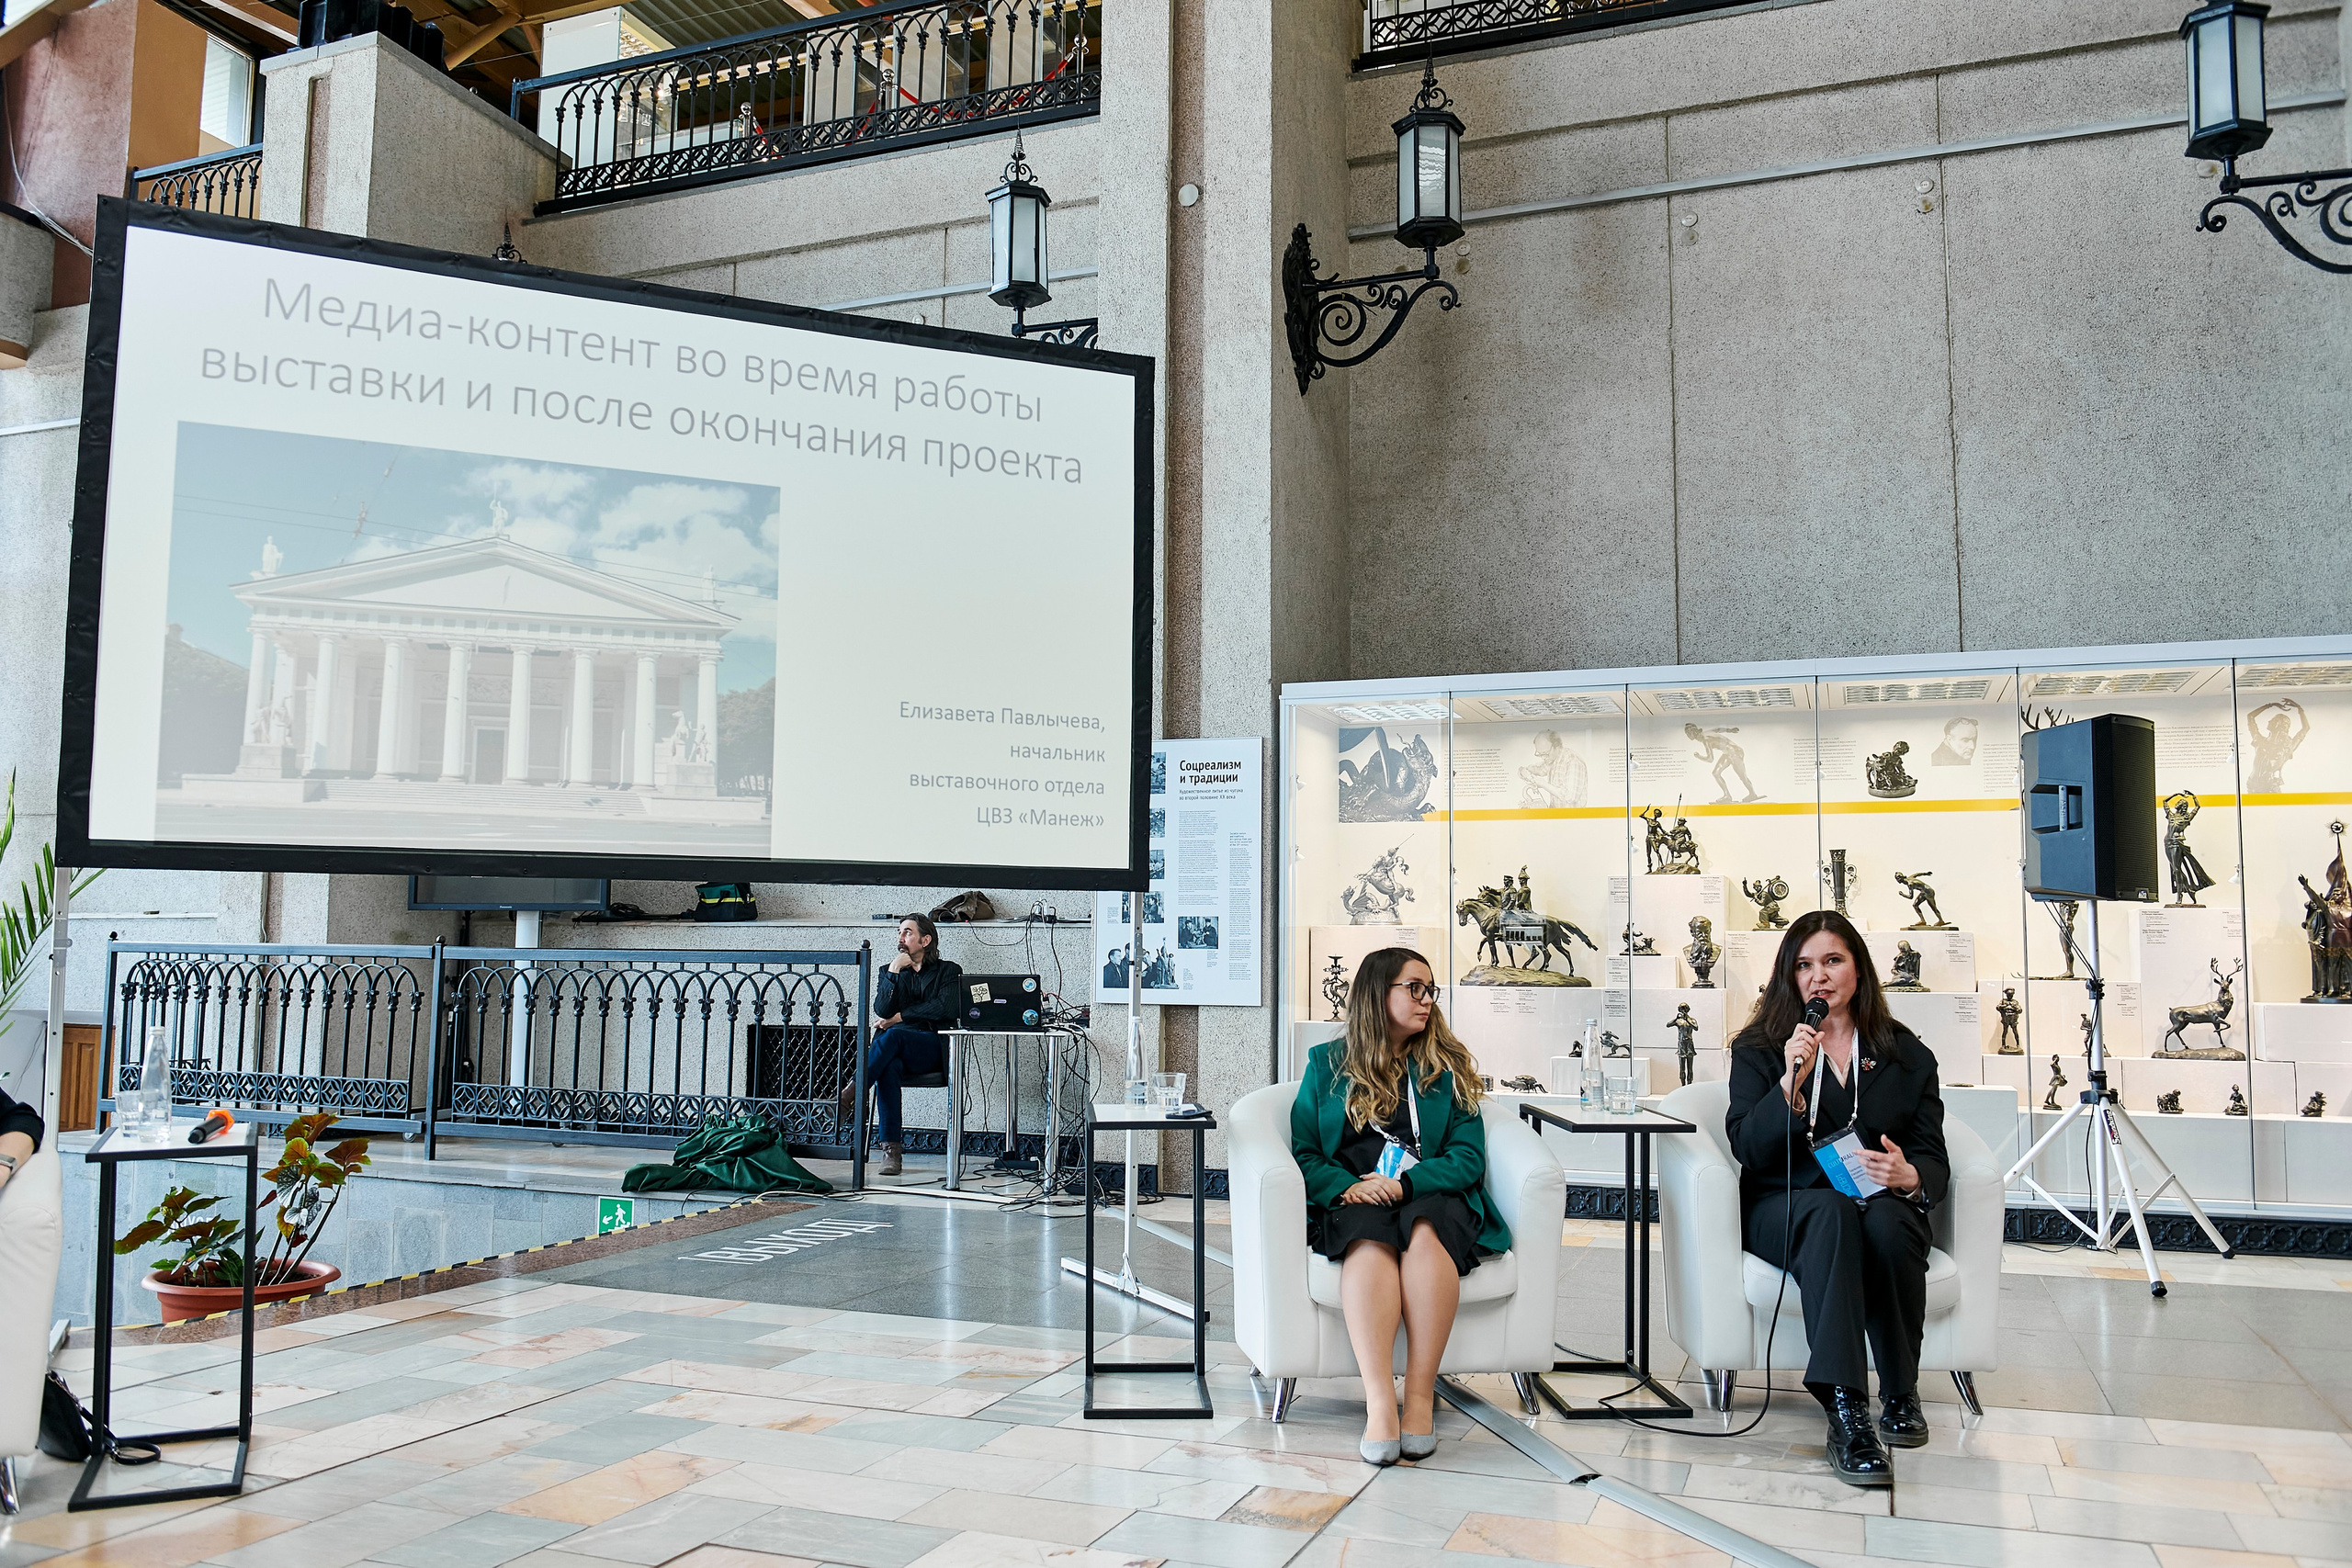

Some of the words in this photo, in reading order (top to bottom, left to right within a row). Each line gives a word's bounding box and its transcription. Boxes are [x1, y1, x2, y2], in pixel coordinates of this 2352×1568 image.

[263, 277, 661, 368] Медиа-контент
[676, 345, 727, 378] во
[744, 354, 876, 399] время
[894, 375, 1041, 423] работы
[201, 347, 445, 406] выставки
[466, 379, 492, 412] и
[513, 386, 652, 431] после
[670, 404, 907, 461] окончания
[923, 438, 1081, 484] проекта
[899, 701, 995, 724] Елизавета
[1001, 707, 1105, 733] Павлычева,
[1010, 745, 1105, 763] начальник
[1179, 760, 1241, 773] Соцреализм
[910, 773, 1039, 792] выставочного
[1045, 779, 1104, 797] отдела
[1180, 775, 1186, 784] и
[1189, 773, 1238, 786] традиции
[977, 807, 1012, 828] ЦВЗ
[1019, 809, 1104, 828] «Манеж»
[694, 1221, 894, 1263] ВЫХОД
